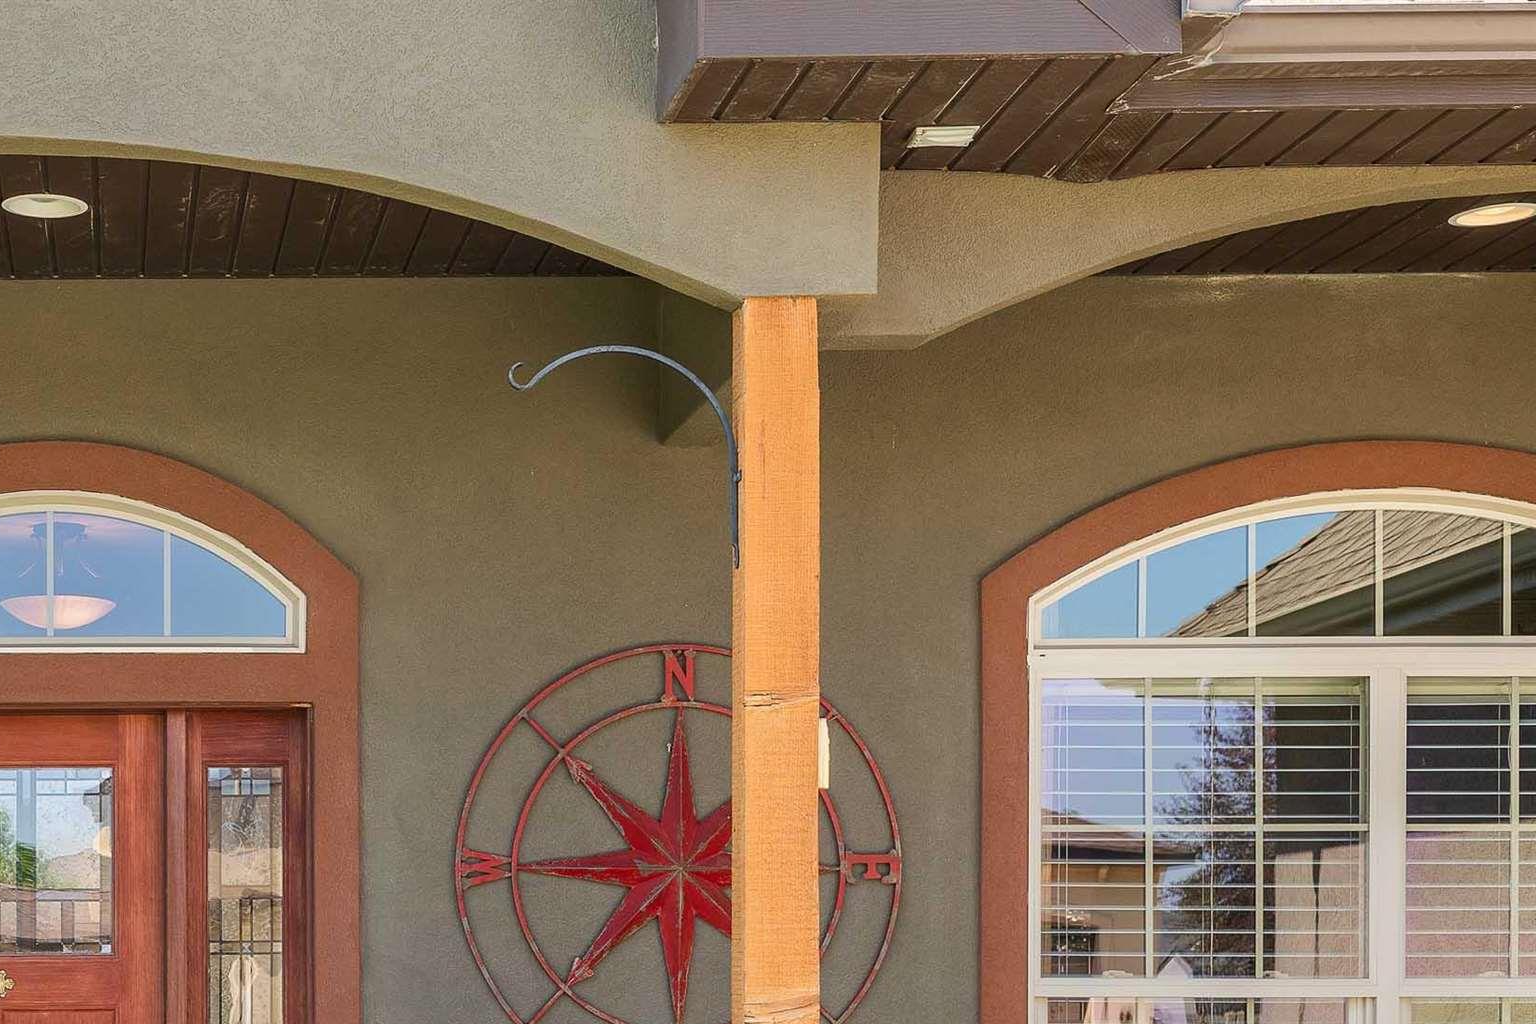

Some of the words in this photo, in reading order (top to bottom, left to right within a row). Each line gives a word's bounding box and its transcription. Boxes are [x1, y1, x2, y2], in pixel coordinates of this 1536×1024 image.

[662, 650, 696, 704] N
[461, 847, 512, 891] W
[845, 850, 901, 885] E
